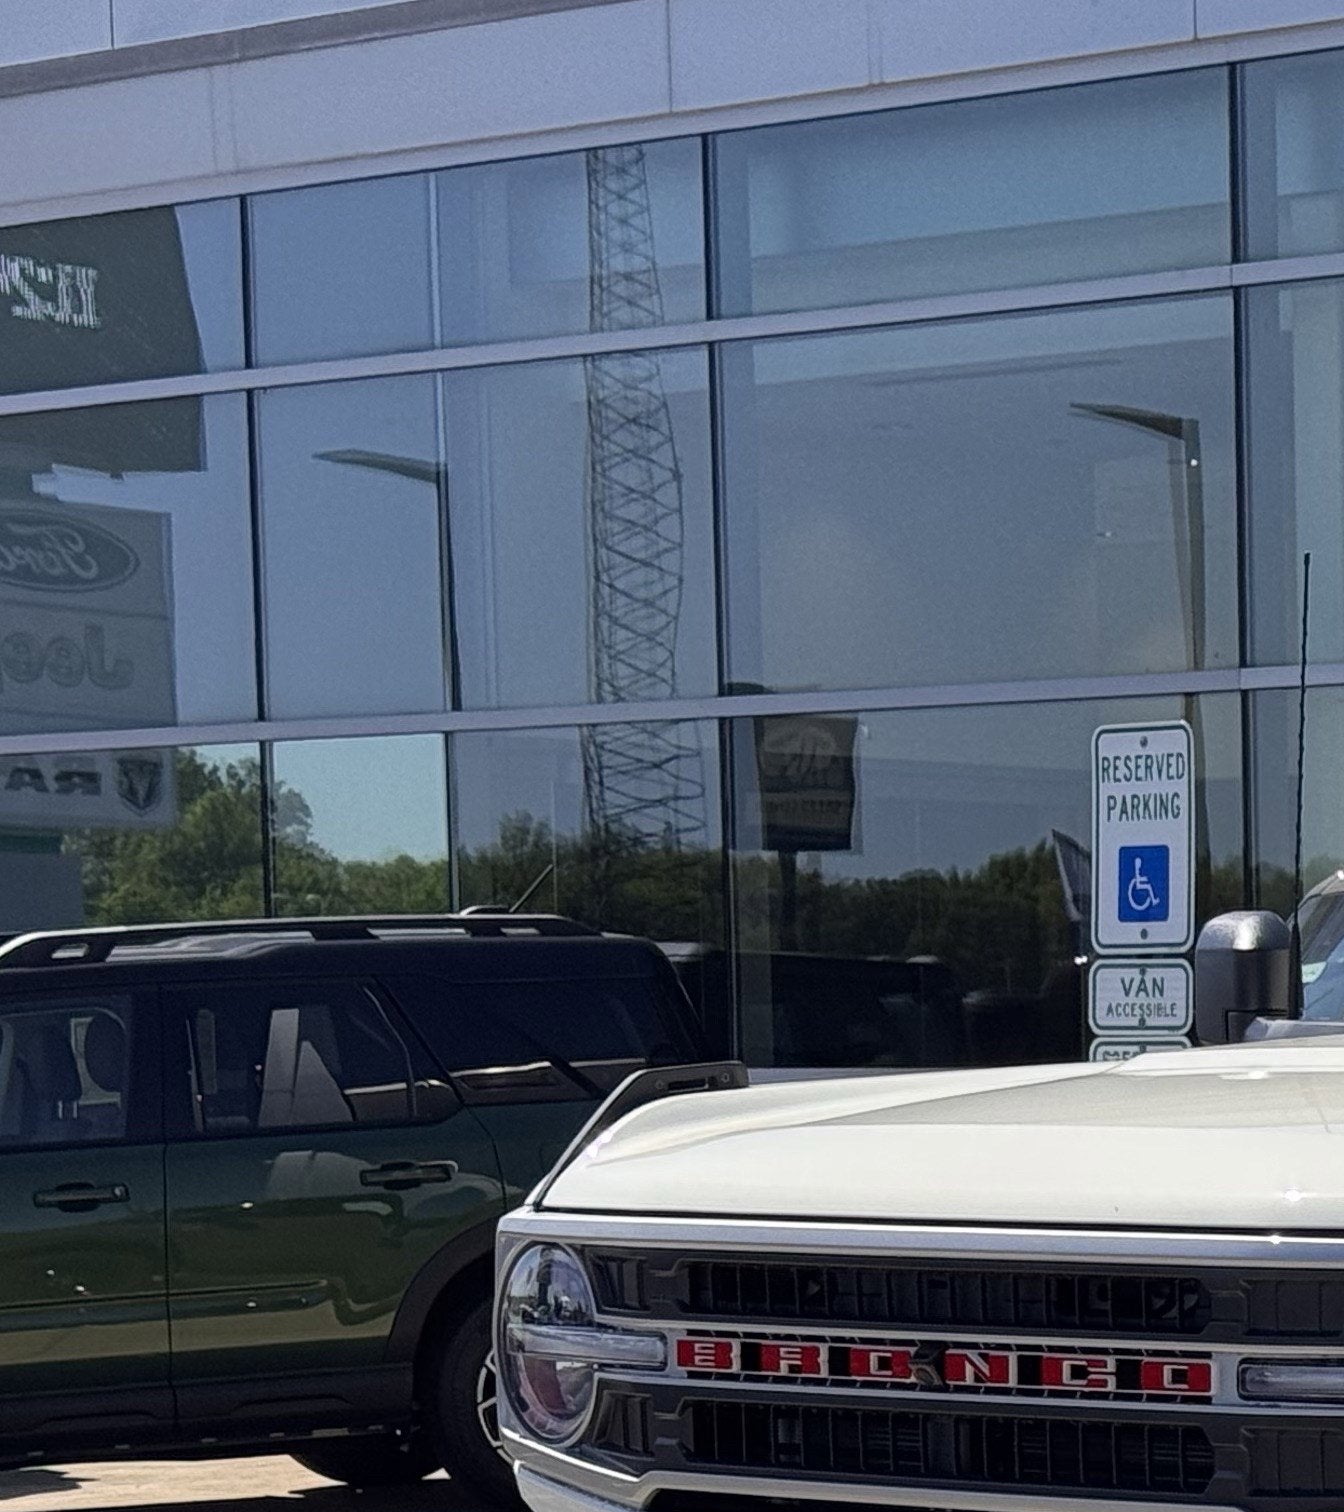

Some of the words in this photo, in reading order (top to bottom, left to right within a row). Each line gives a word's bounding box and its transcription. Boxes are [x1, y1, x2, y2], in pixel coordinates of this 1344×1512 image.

[1102, 752, 1186, 784] RESERVED
[1107, 792, 1182, 822] PARKING
[1120, 976, 1165, 998] VAN
[1105, 1002, 1178, 1018] ACCESSIBLE
[675, 1339, 1215, 1395] BRONCO
